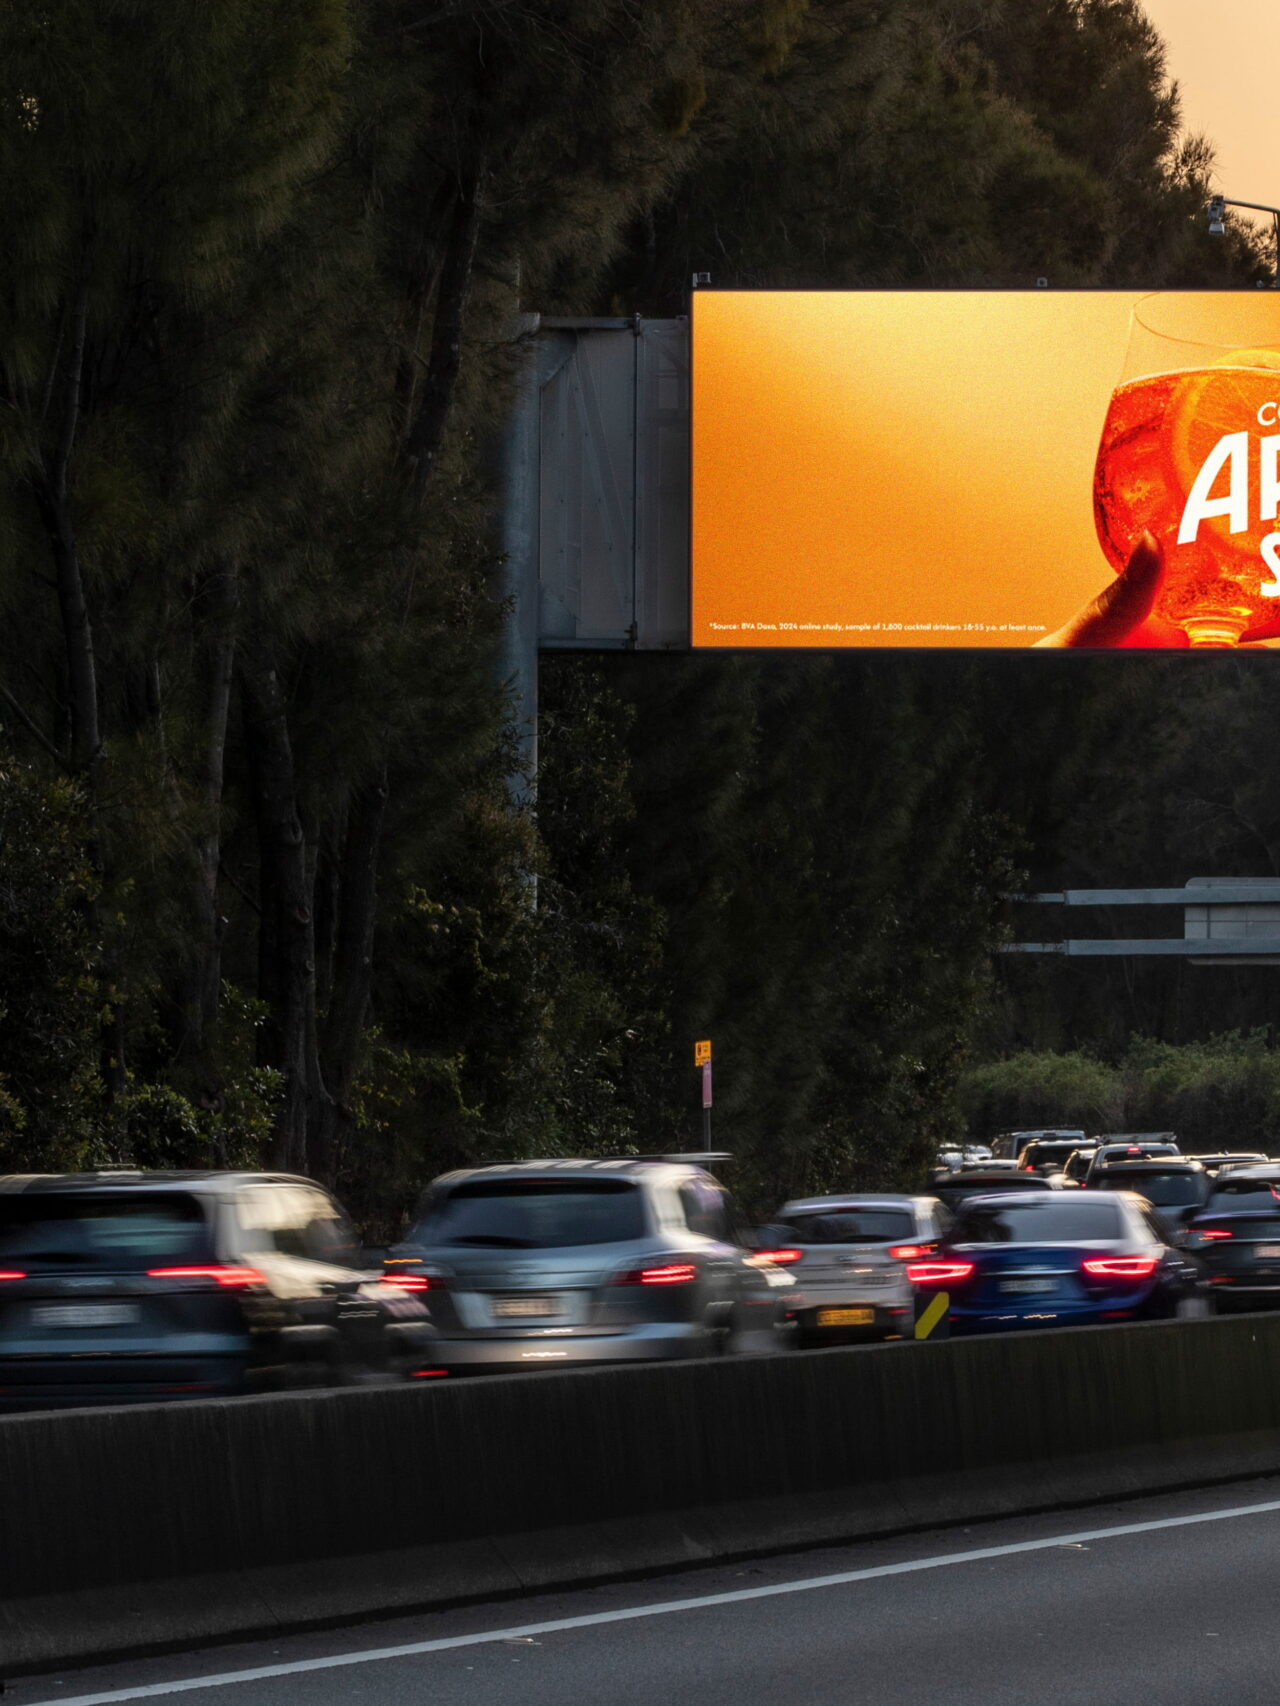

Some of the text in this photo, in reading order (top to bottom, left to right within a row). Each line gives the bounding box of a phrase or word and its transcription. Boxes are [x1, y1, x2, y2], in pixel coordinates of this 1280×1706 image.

[779, 622, 798, 631] 2024
[799, 622, 821, 631] online
[822, 622, 844, 633] study,
[845, 622, 871, 633] sample
[872, 622, 880, 631] of
[903, 622, 932, 631] cocktail
[933, 622, 961, 631] drinkers
[999, 622, 1007, 631] at
[1008, 622, 1026, 631] least
